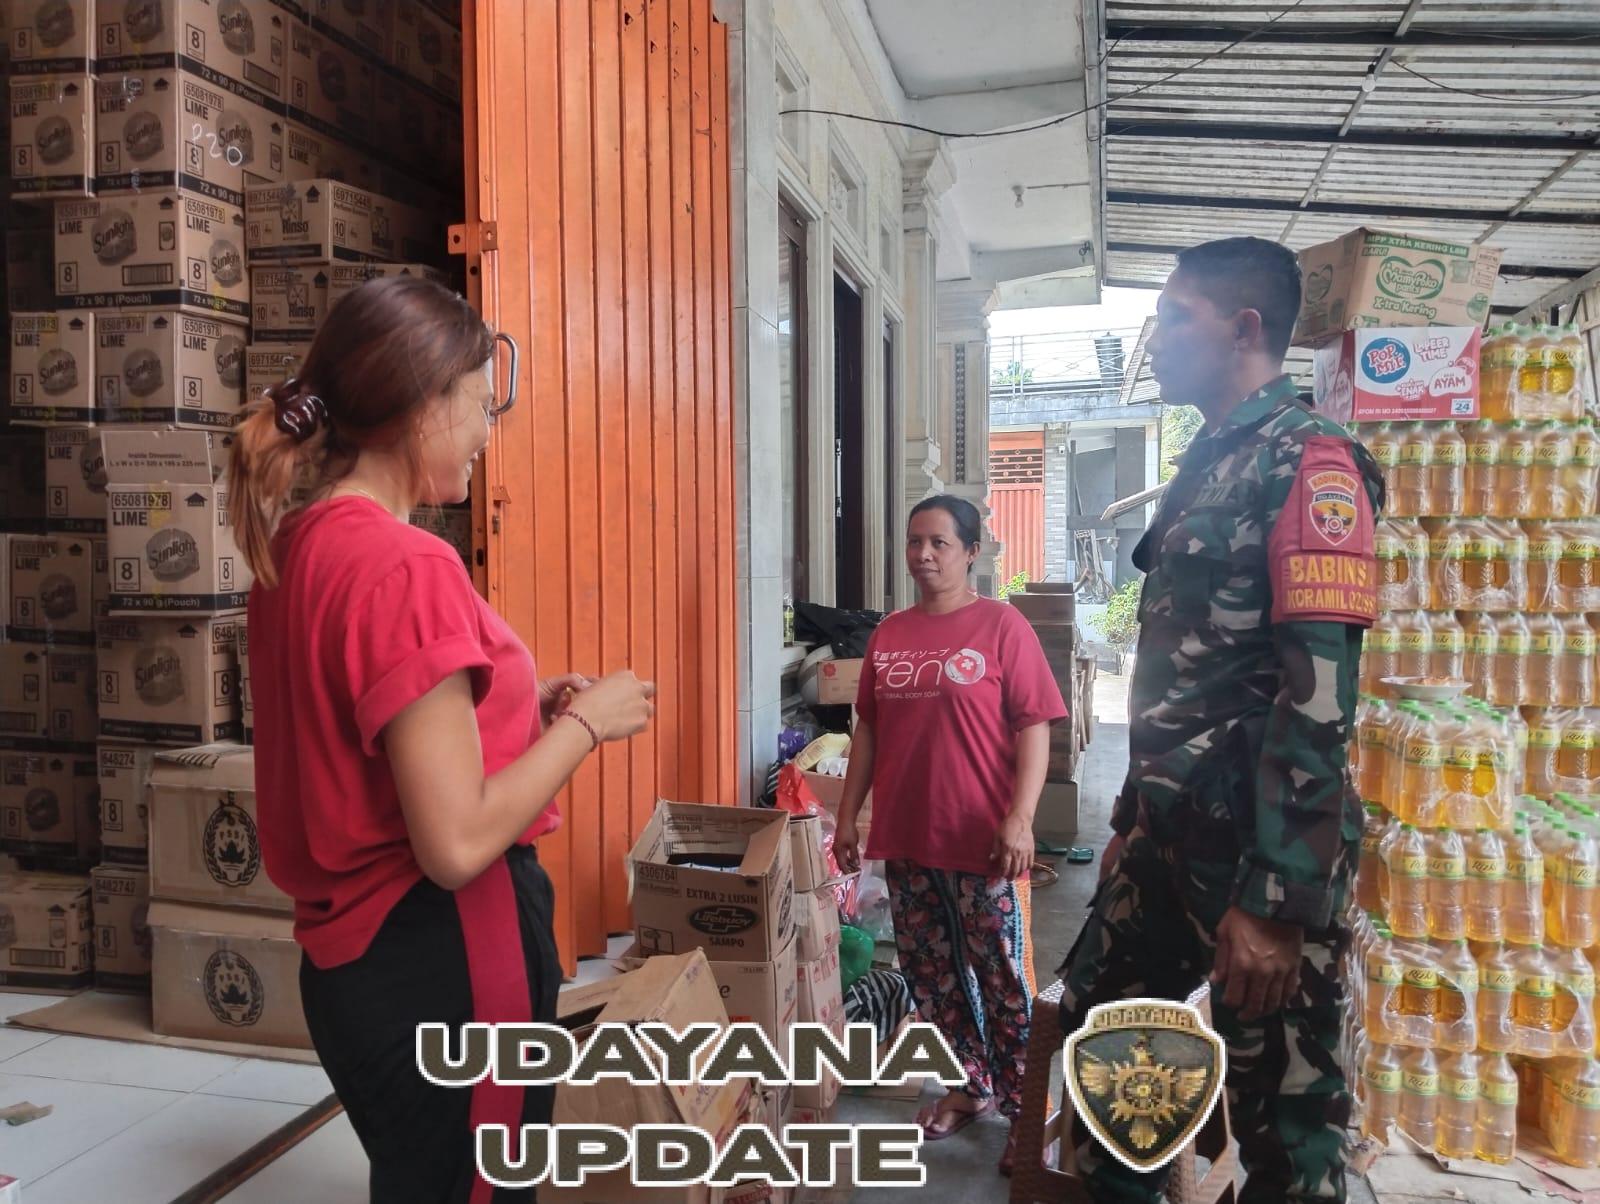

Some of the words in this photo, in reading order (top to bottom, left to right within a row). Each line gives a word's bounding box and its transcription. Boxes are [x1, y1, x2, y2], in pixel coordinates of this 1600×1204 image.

[18, 31, 27, 48] 8
[106, 27, 116, 45] 8
[191, 31, 201, 49] 8
[13, 103, 38, 117] LIME
[100, 99, 126, 113] LIME
[185, 100, 209, 120] LIME
[18, 149, 27, 166] 8
[105, 145, 115, 163] 8
[59, 220, 83, 235] LIME
[186, 215, 211, 233] LIME
[281, 219, 309, 234] Rinso
[94, 218, 135, 255] Sunlight
[1389, 237, 1413, 249] XTRA
[1414, 240, 1448, 253] KERING
[211, 249, 241, 275] Sunlight
[64, 266, 73, 282] 8
[193, 262, 202, 280] 8
[115, 293, 152, 306] (Pouch)
[289, 304, 316, 318] Rinso
[1401, 300, 1437, 319] Kering
[100, 334, 126, 348] LIME
[183, 337, 208, 352] LIME
[1367, 344, 1396, 365] POP
[1419, 349, 1449, 362] TIME
[19, 378, 28, 394] 8
[188, 380, 197, 398] 8
[1434, 376, 1466, 390] AYAM
[1454, 403, 1471, 412] 24
[48, 446, 73, 460] LIME
[54, 489, 63, 506] 8
[113, 494, 169, 508] 65081978
[112, 511, 148, 527] LIME
[15, 557, 41, 571] LIME
[149, 540, 197, 571] Sunlight
[121, 562, 133, 581] 8
[221, 562, 231, 580] 8
[164, 597, 201, 608] (Pouch)
[1286, 588, 1348, 610] KORAMIL
[135, 655, 182, 691] Sunlight
[106, 673, 114, 694] 8
[220, 672, 231, 694] 8
[108, 802, 118, 822] 8
[686, 888, 718, 901] EXTRA
[694, 911, 751, 927] Lifebuoy
[102, 929, 111, 949] 8
[708, 936, 745, 948] SAMPO
